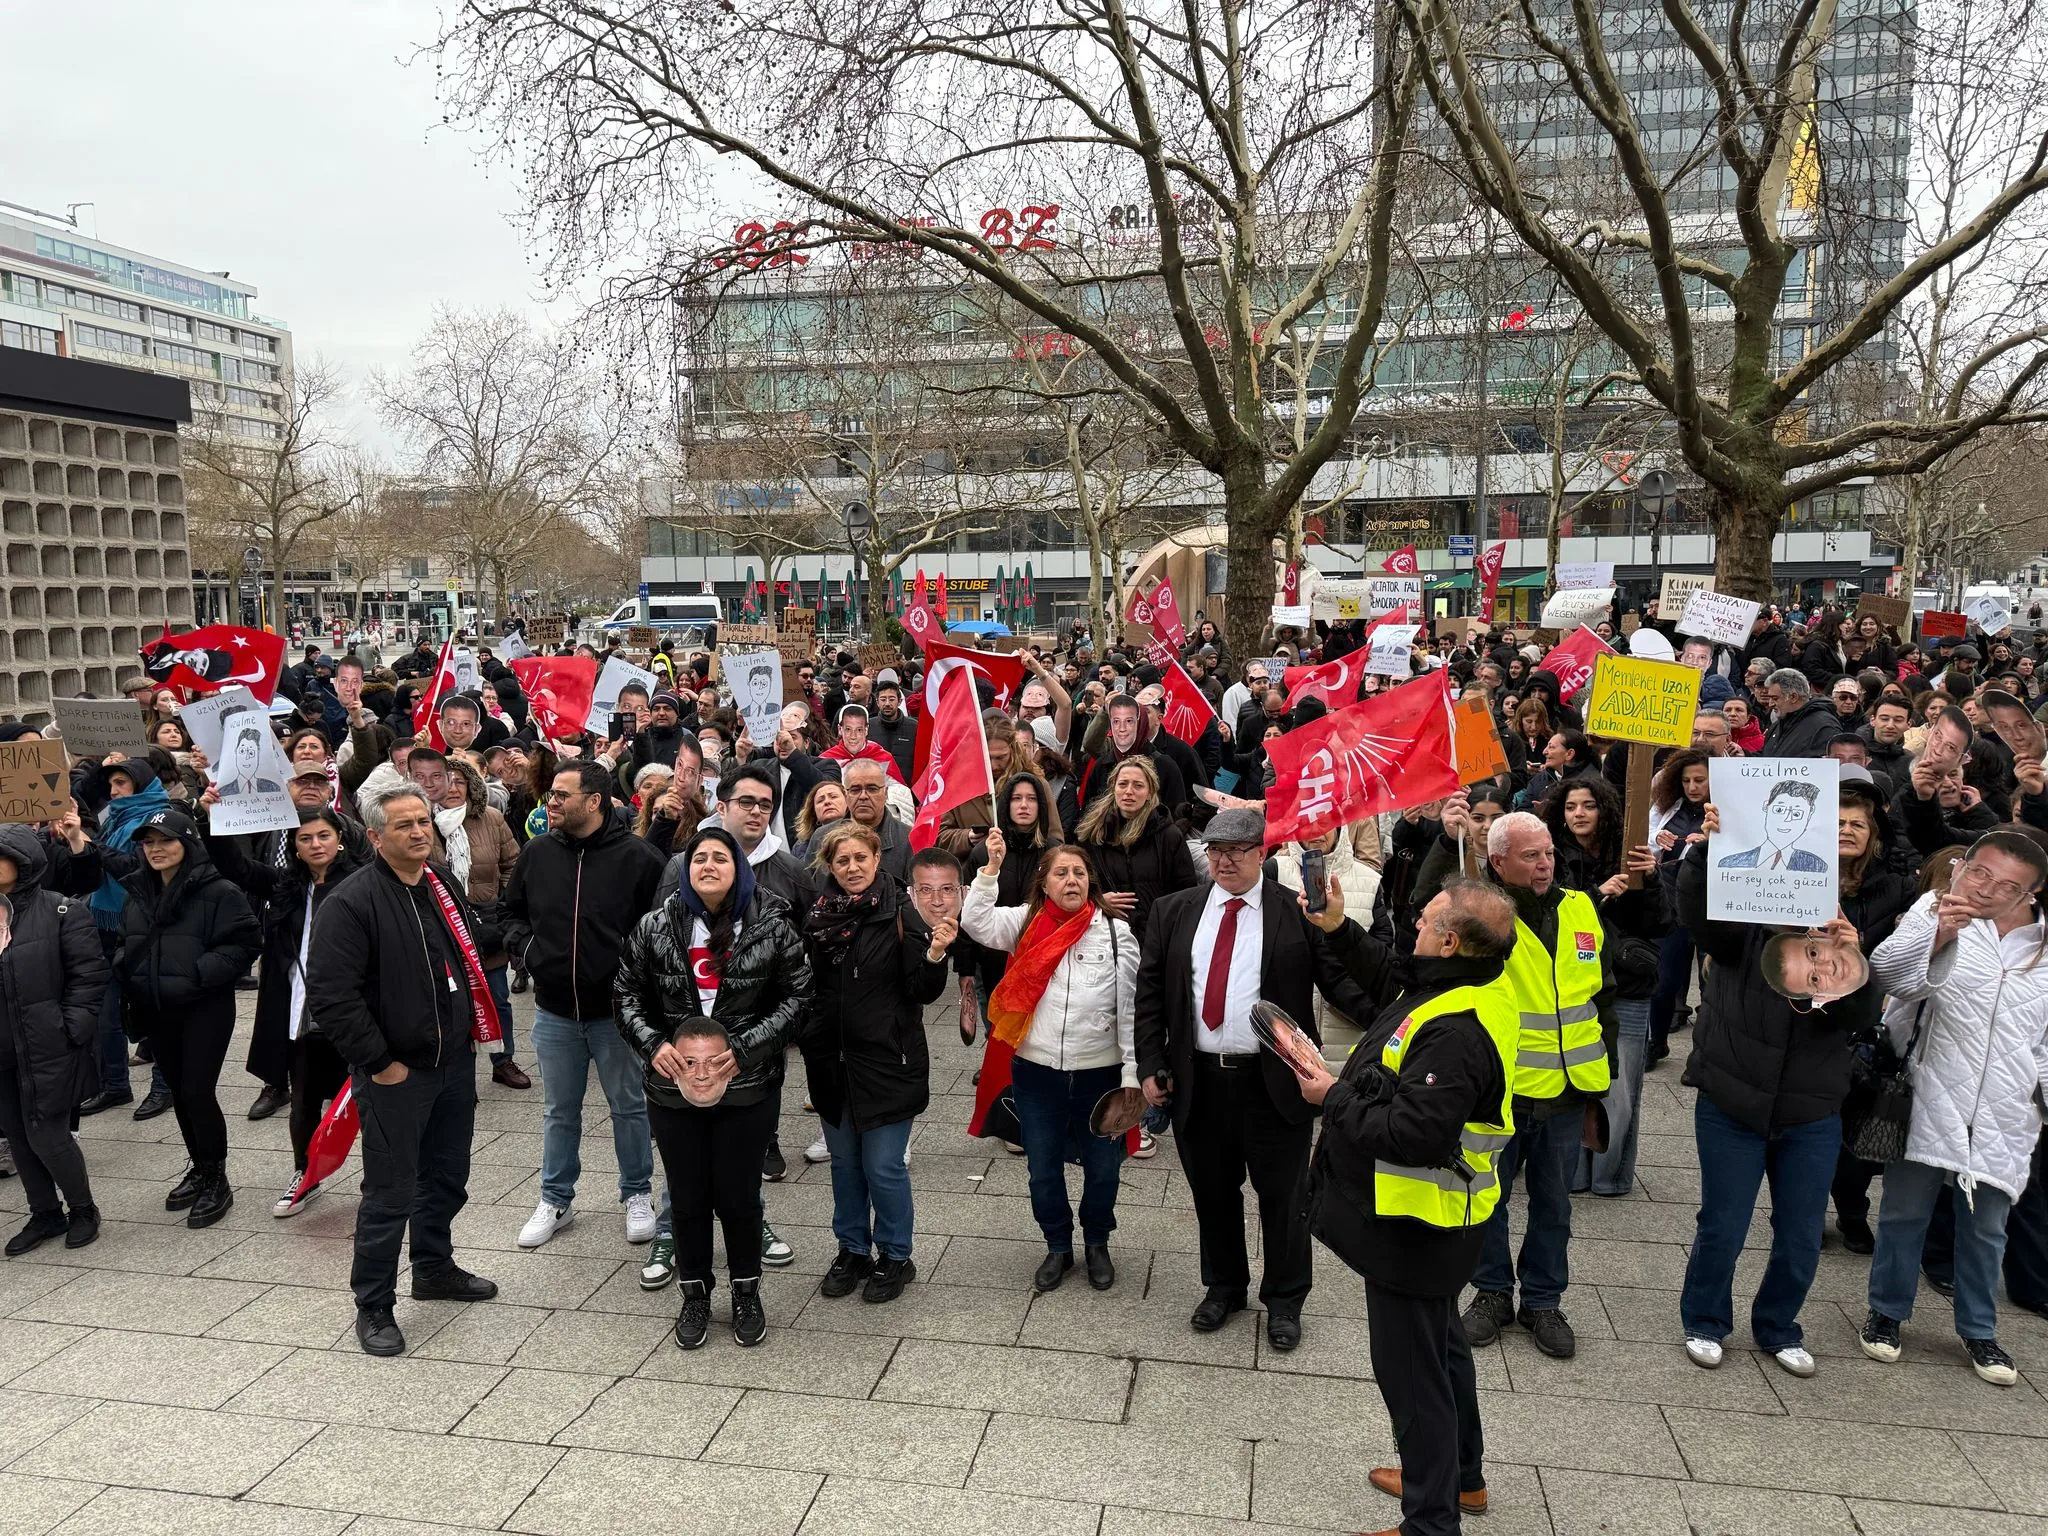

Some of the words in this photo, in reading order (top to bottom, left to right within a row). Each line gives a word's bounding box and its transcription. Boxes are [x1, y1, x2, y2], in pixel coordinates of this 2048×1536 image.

[1404, 582, 1420, 593] FALL
[1700, 591, 1750, 610] EUROPA!!!
[1547, 608, 1577, 619] WEGEN
[1691, 599, 1743, 621] Verteidige
[529, 619, 544, 628] STOP
[545, 617, 563, 625] POLICE
[529, 624, 557, 634] CRIMES
[1712, 615, 1745, 631] WERTE
[539, 632, 564, 640] TURKEY
[864, 655, 896, 667] ADALET
[1601, 663, 1657, 691] Memleket
[1599, 690, 1689, 726] ADALET
[1592, 715, 1623, 733] daha
[1627, 722, 1643, 737] da
[1740, 760, 1810, 777] üzülme
[245, 805, 271, 815] olacak
[225, 814, 289, 830] #alleswirdgut
[1721, 871, 1742, 882] Her
[1745, 876, 1762, 888] şey
[1768, 874, 1786, 885] çok
[1794, 877, 1828, 890] güzel
[1755, 888, 1796, 900] olacak
[1725, 901, 1821, 919] #alleswirdgut
[1577, 951, 1595, 961] CHP
[474, 1008, 491, 1041] RAMS
